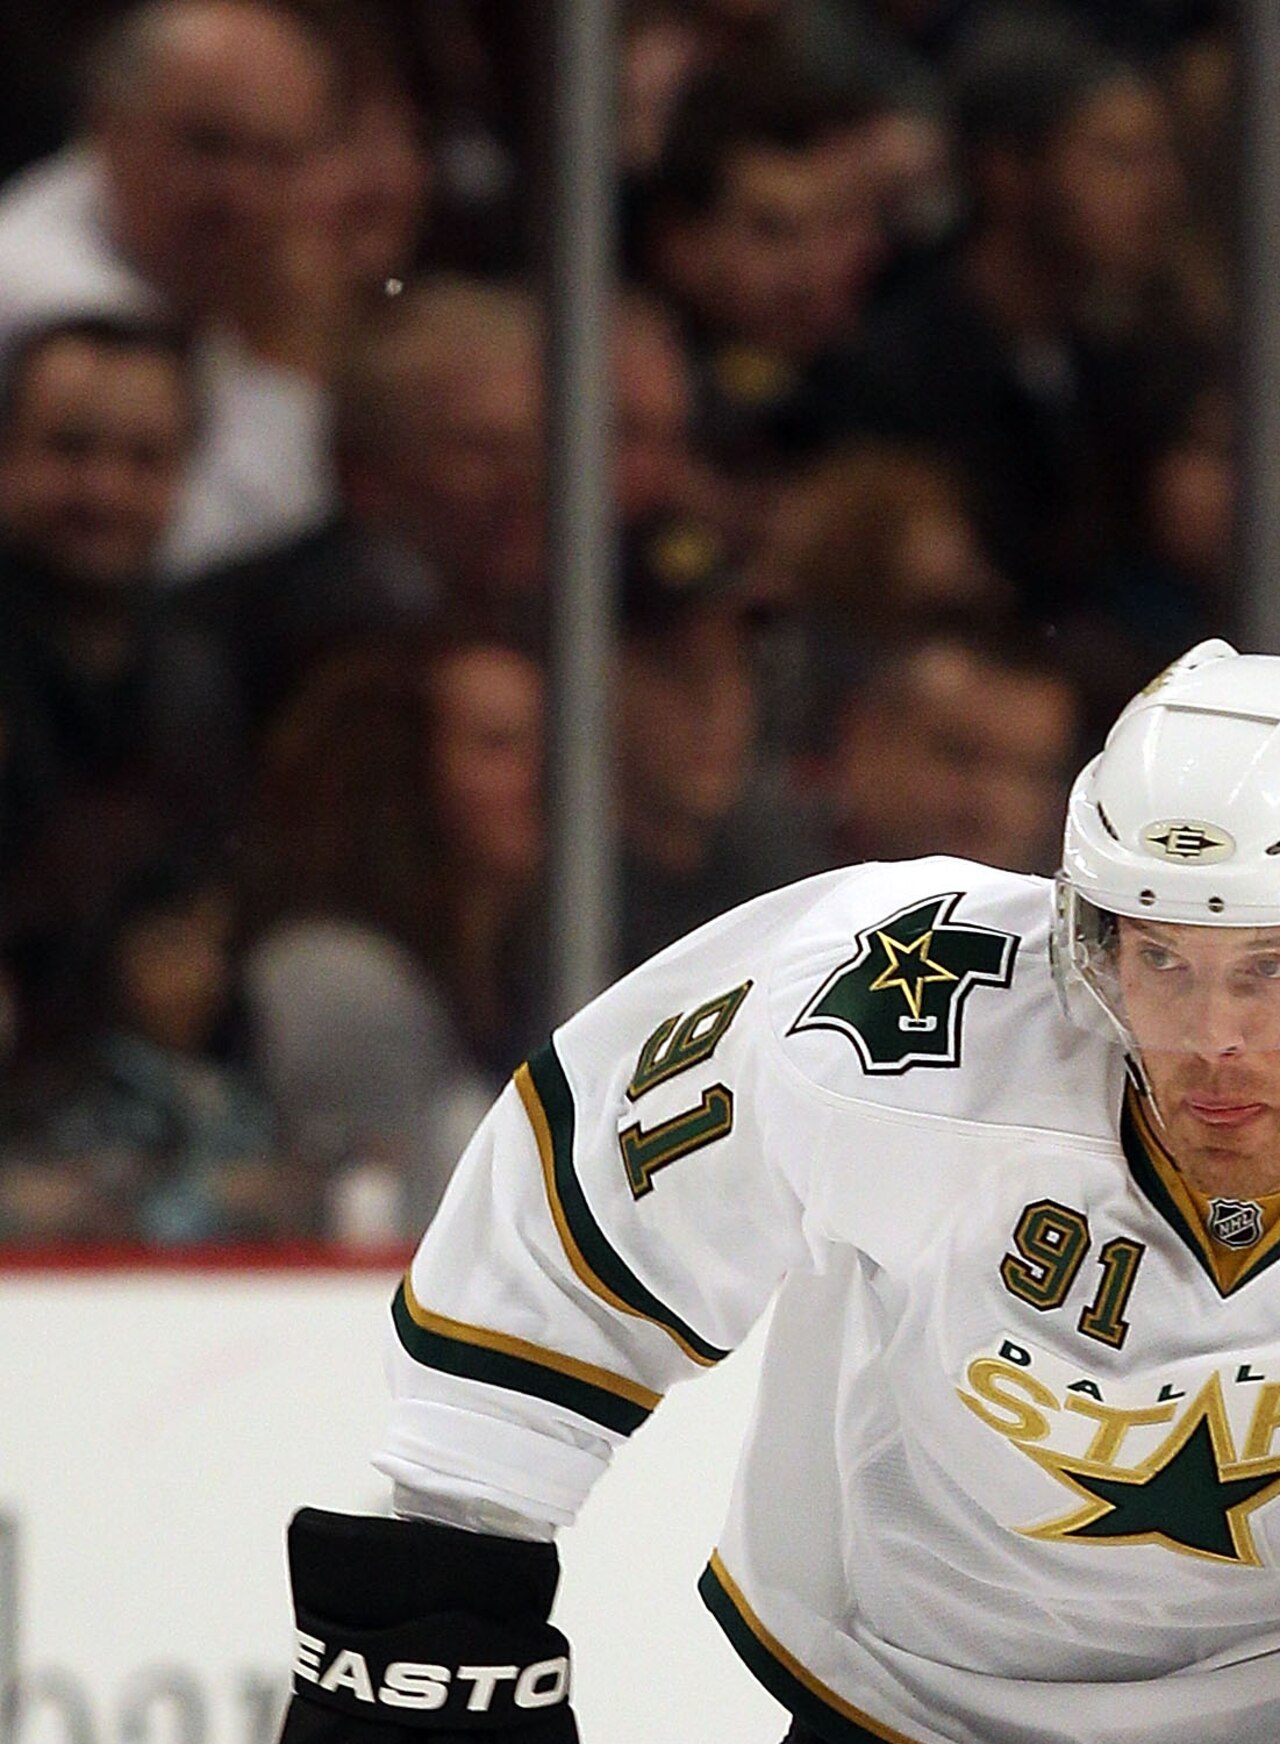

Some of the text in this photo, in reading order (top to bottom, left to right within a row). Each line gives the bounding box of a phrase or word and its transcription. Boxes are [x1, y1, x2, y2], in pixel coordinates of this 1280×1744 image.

[619, 979, 753, 1201] 91
[1000, 1198, 1146, 1350] 91
[1218, 1211, 1256, 1237] NHL
